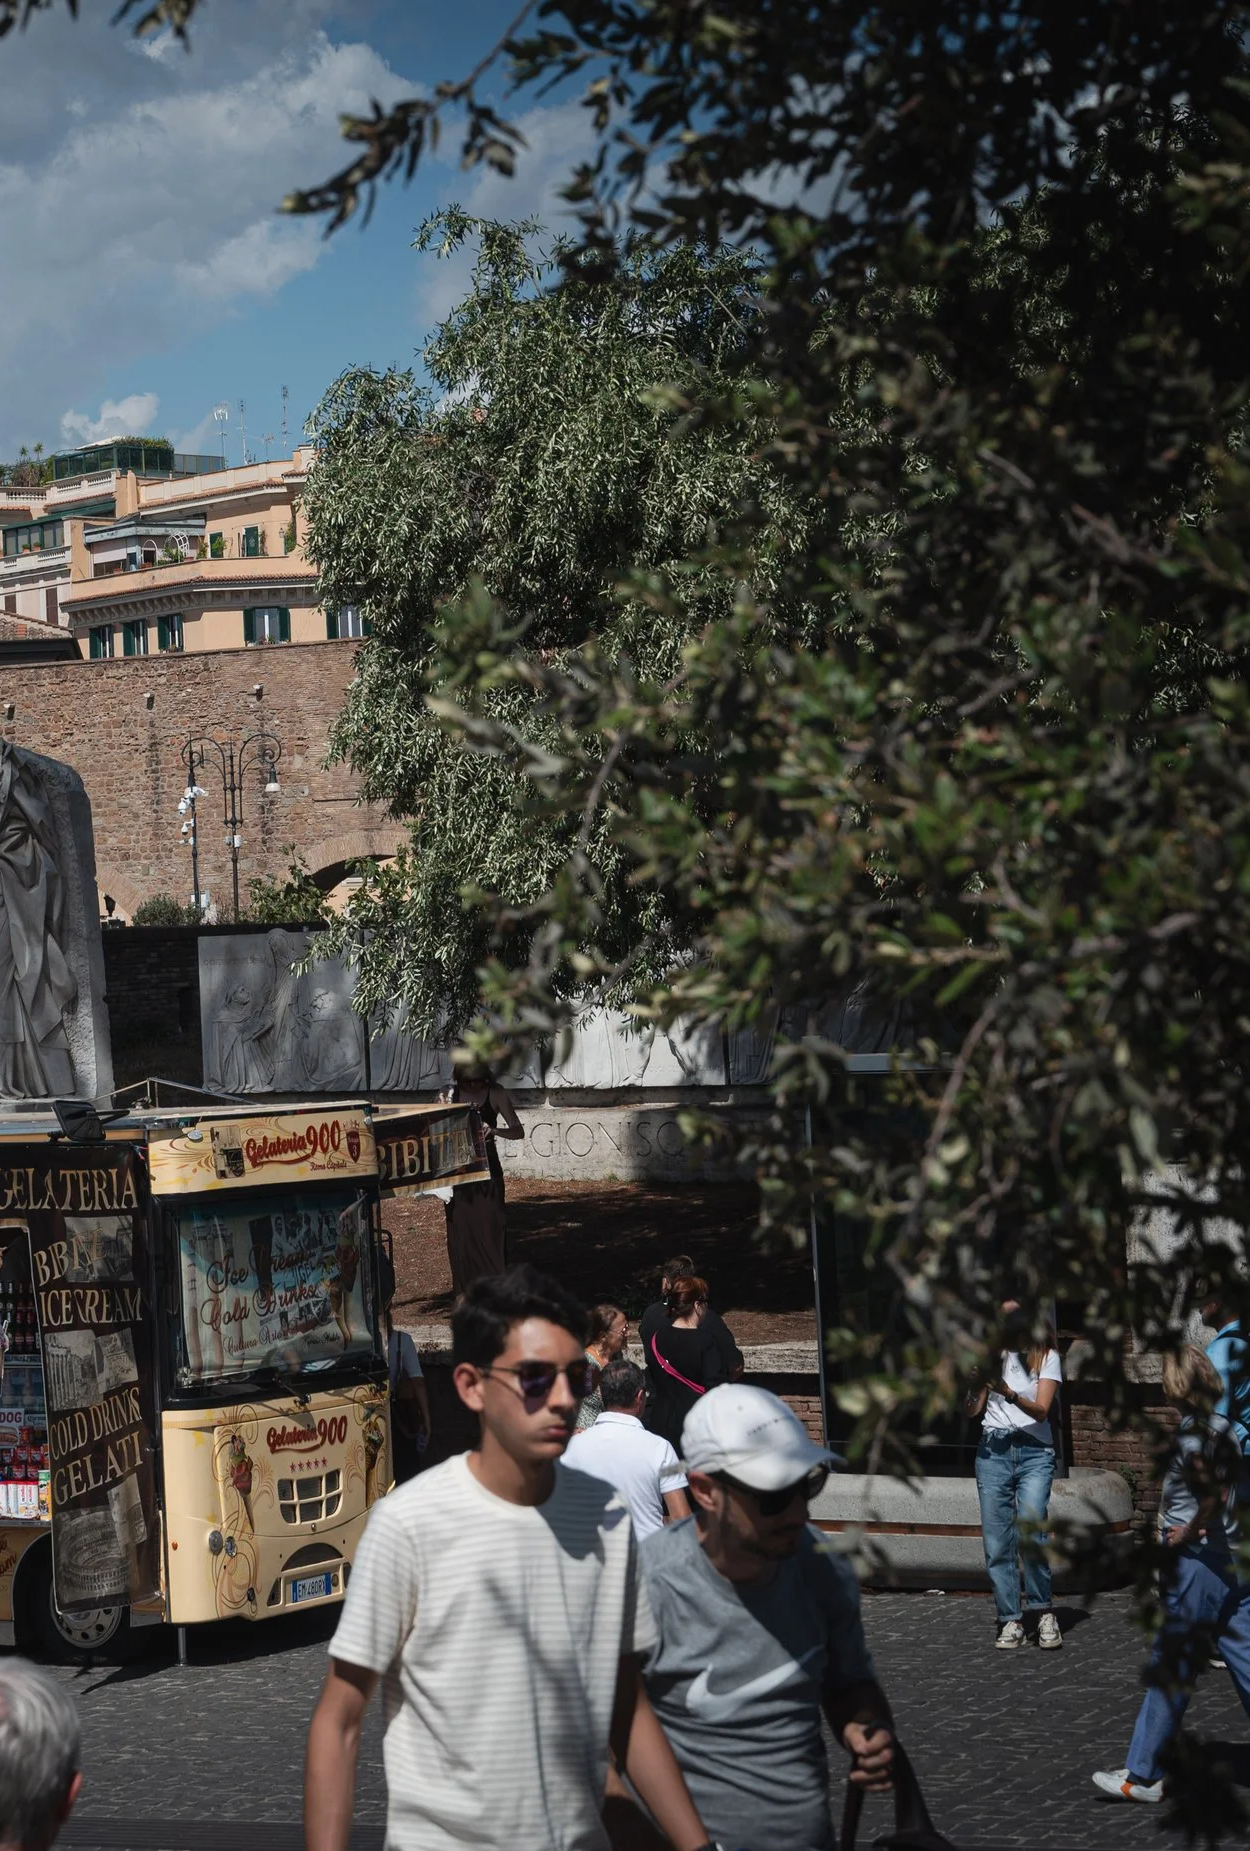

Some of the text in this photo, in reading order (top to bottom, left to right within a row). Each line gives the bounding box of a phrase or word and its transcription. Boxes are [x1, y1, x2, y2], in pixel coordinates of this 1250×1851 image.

[245, 1119, 341, 1168] Gelateria 900
[200, 1295, 250, 1331] Cold
[252, 1281, 320, 1317] Drinks
[49, 1411, 88, 1461] COLD
[266, 1415, 348, 1454] Gelateria 900
[52, 1430, 144, 1506] GELATI
